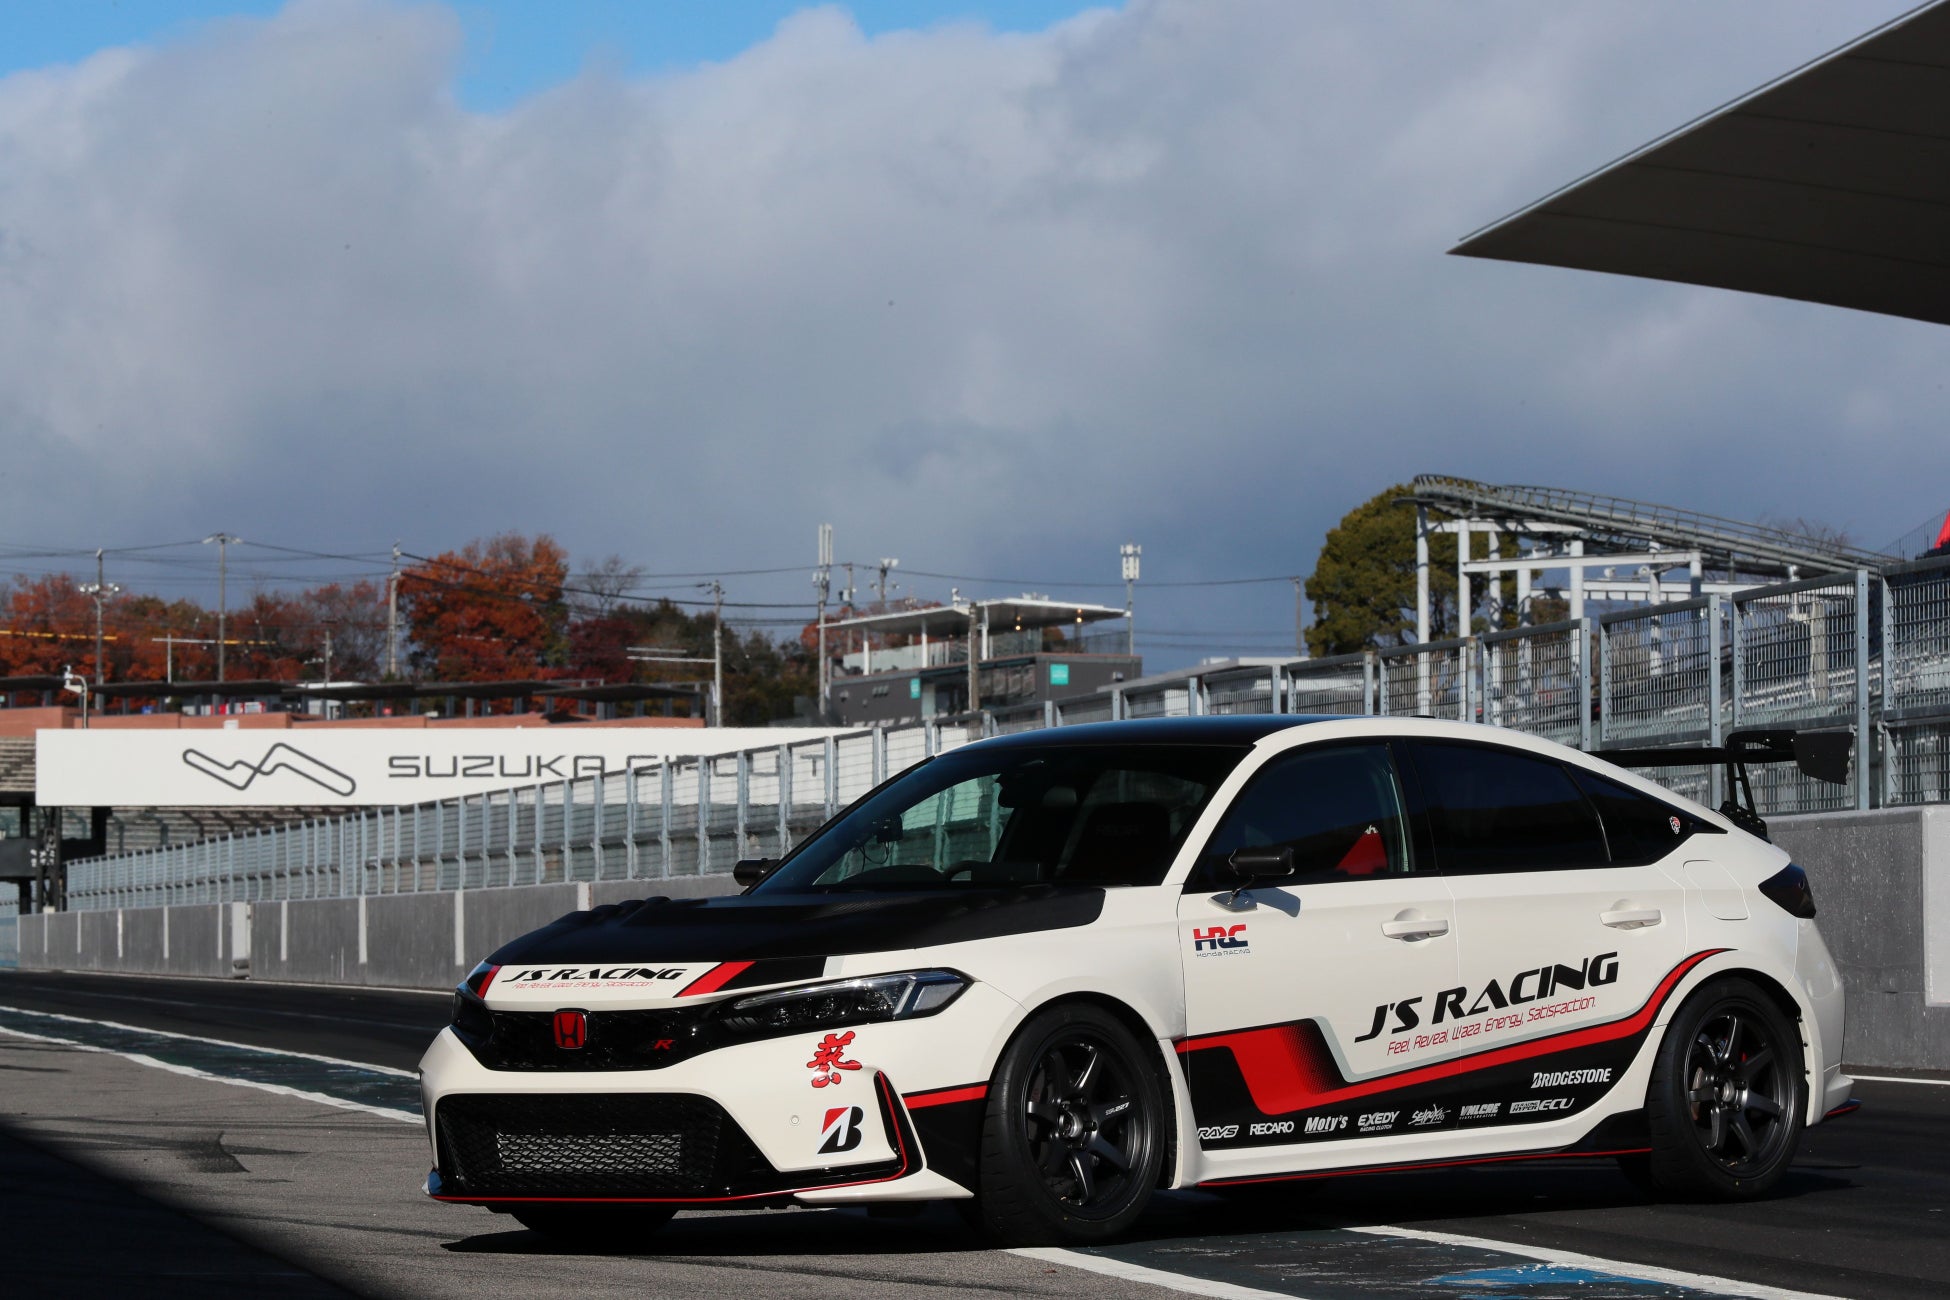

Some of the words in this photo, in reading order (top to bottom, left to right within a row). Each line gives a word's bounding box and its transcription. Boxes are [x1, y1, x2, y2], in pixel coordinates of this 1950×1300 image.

[388, 755, 605, 778] SUZUKA
[1193, 924, 1248, 951] HRC
[547, 968, 688, 981] RACING
[1354, 996, 1423, 1044] J'S
[1431, 951, 1619, 1025] RACING
[1531, 1068, 1612, 1089] BRIDGESTONE
[1538, 1097, 1575, 1111] ECU
[1304, 1114, 1349, 1133] Moty's
[1357, 1111, 1401, 1127] EXEDY
[1198, 1125, 1239, 1140] RAYS
[1250, 1121, 1294, 1136] RECARO
